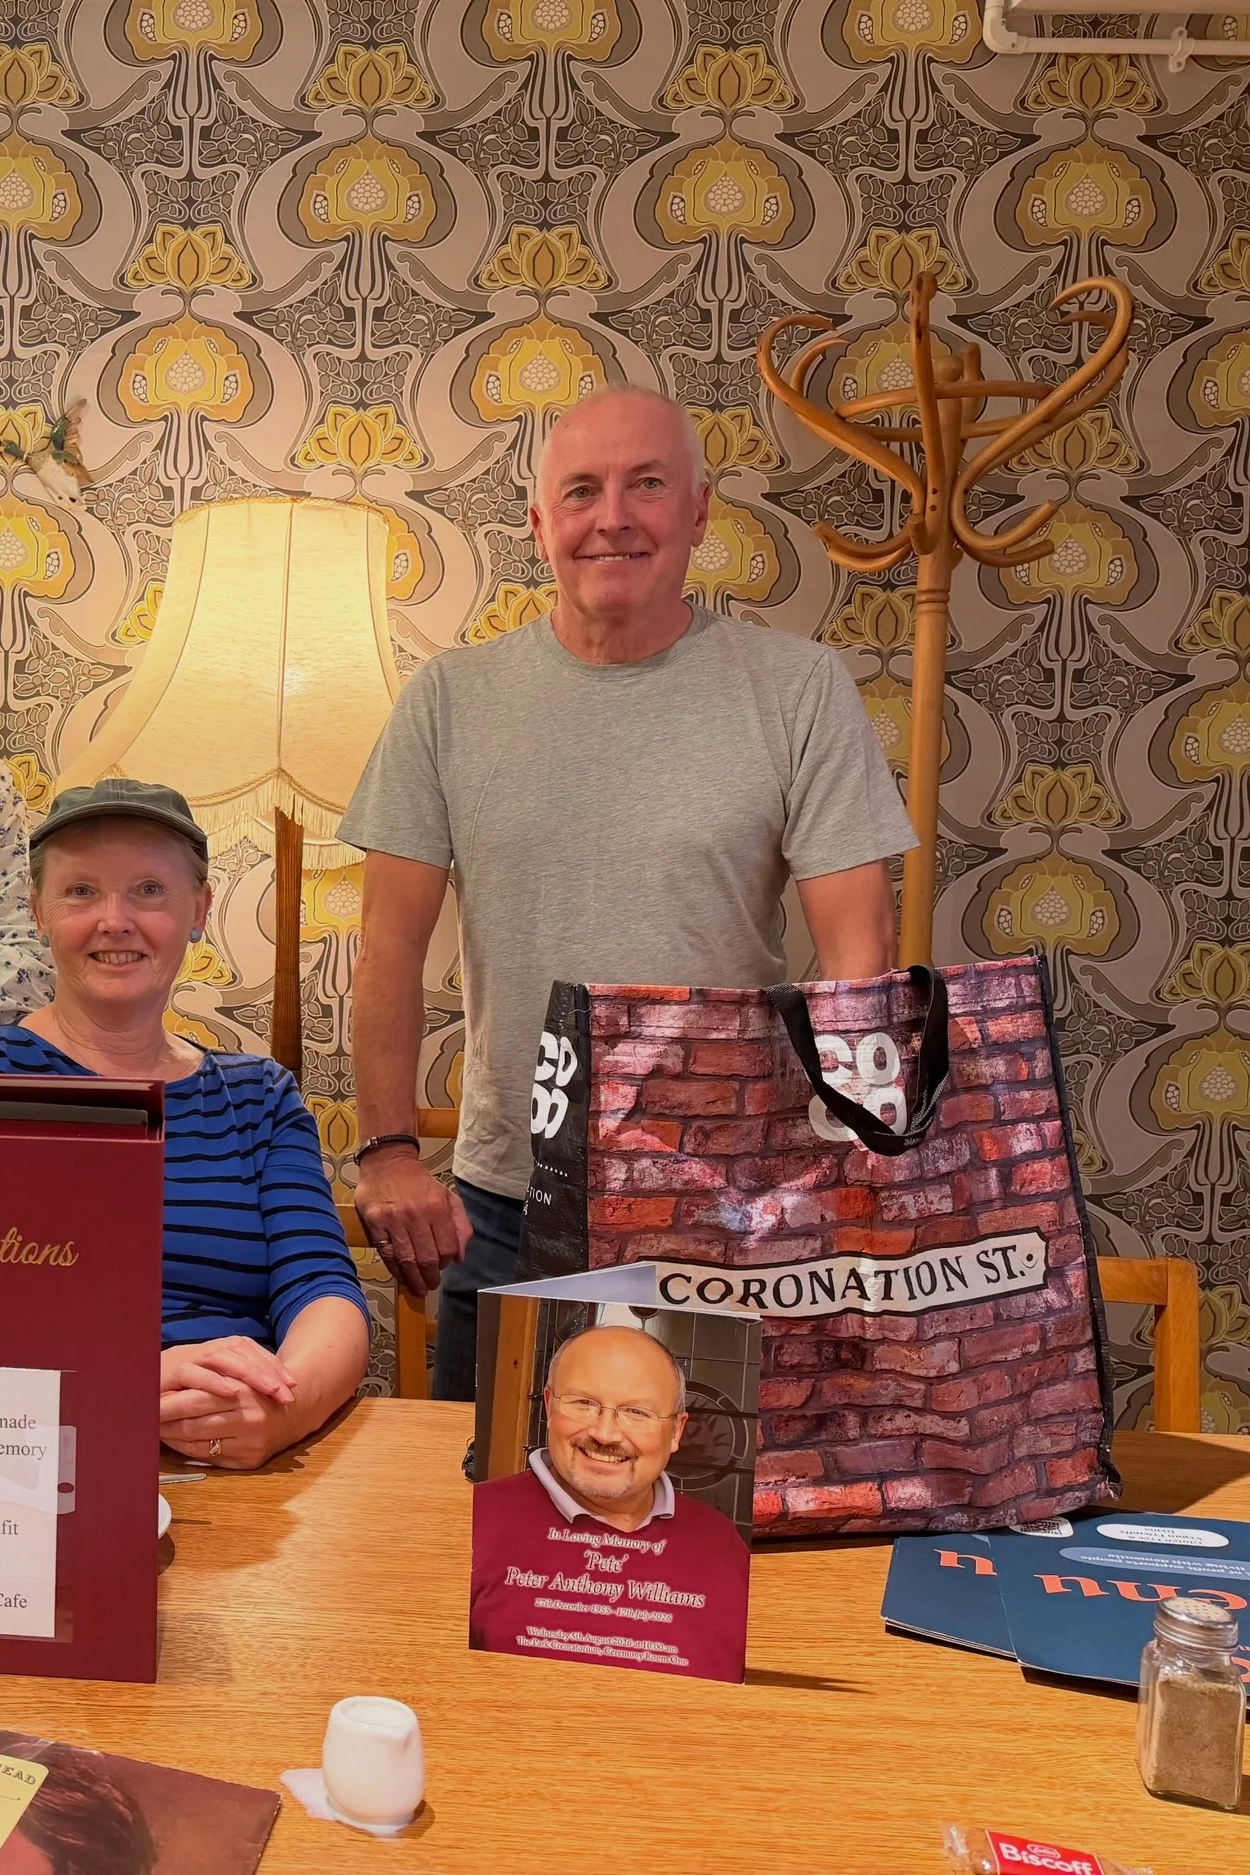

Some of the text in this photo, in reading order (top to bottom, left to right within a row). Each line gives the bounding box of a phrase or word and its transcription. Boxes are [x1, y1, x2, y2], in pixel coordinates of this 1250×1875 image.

[659, 1243, 1026, 1309] CORONATION ST.
[547, 1527, 668, 1556] In Loving Memory of
[504, 1566, 706, 1609] Peter Anthony Williams
[552, 1599, 591, 1614] December
[634, 1609, 651, 1621] July
[516, 1635, 532, 1647] The
[532, 1636, 551, 1648] Park
[603, 1646, 644, 1662] Ceremony
[644, 1652, 671, 1664] Room
[671, 1656, 690, 1667] One
[525, 1625, 570, 1641] Wednesday
[584, 1634, 612, 1646] August
[664, 1645, 679, 1654] am
[999, 1842, 1094, 1875] Biscoff
